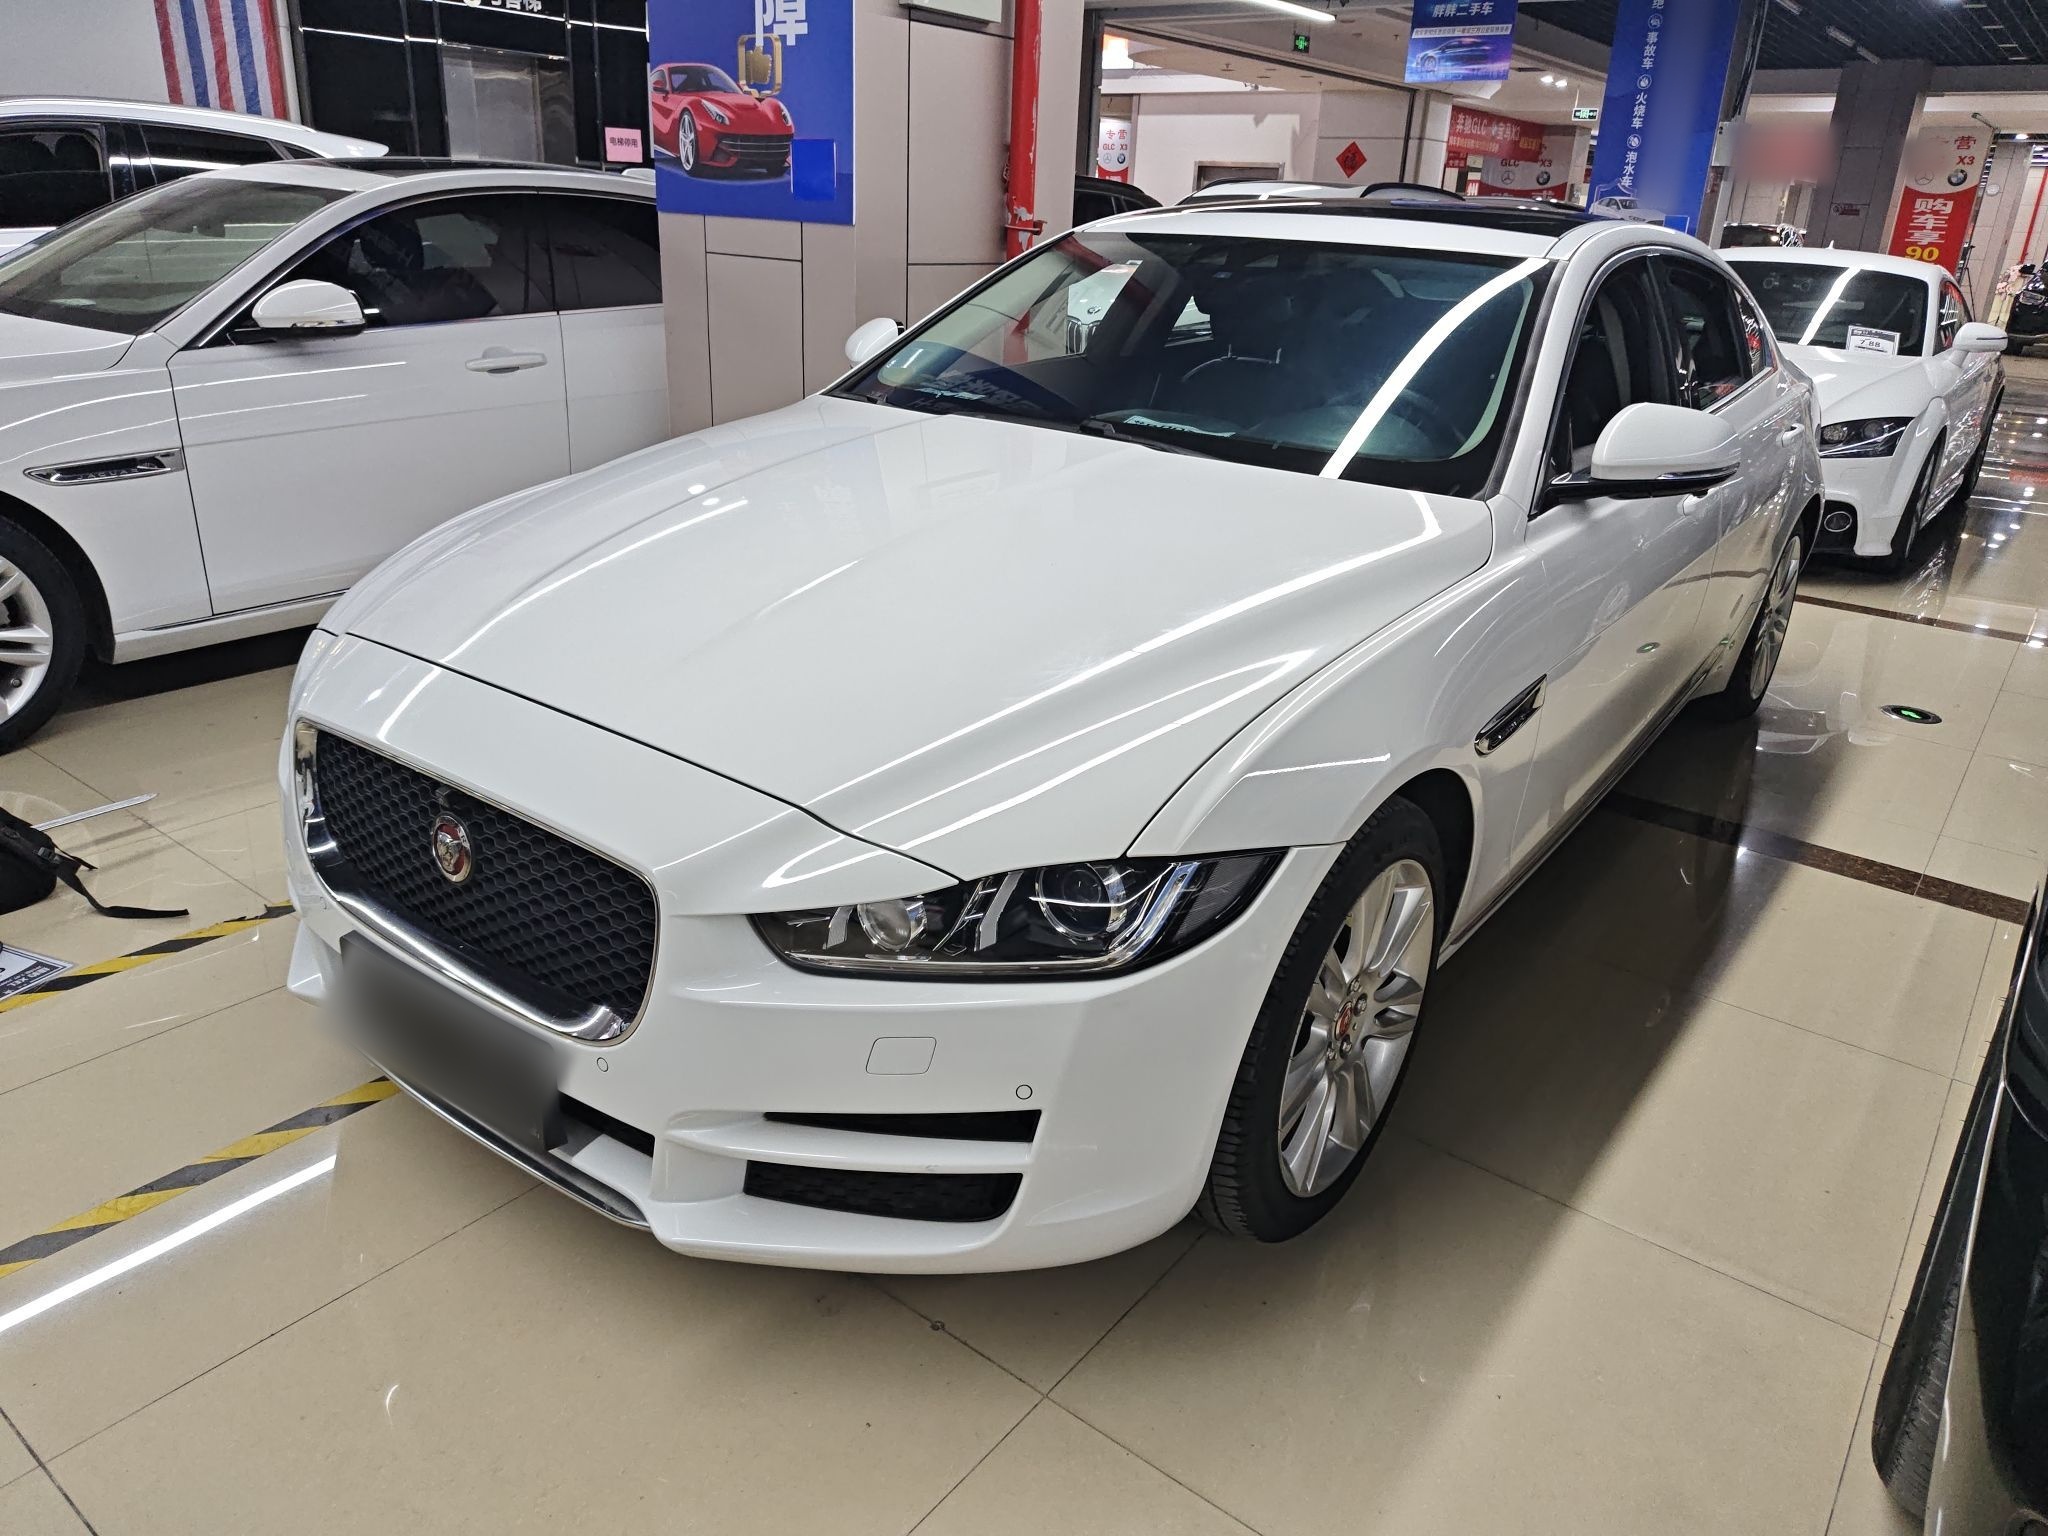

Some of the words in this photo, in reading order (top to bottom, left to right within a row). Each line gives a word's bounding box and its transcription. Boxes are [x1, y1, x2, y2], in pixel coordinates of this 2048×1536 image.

[1641, 32, 1659, 69] 事故车
[1631, 92, 1648, 129] 火烧车
[1621, 151, 1638, 188] 泡水车
[1956, 155, 1976, 165] X3
[1905, 198, 1954, 245] 购车享
[1905, 246, 1939, 261] 90
